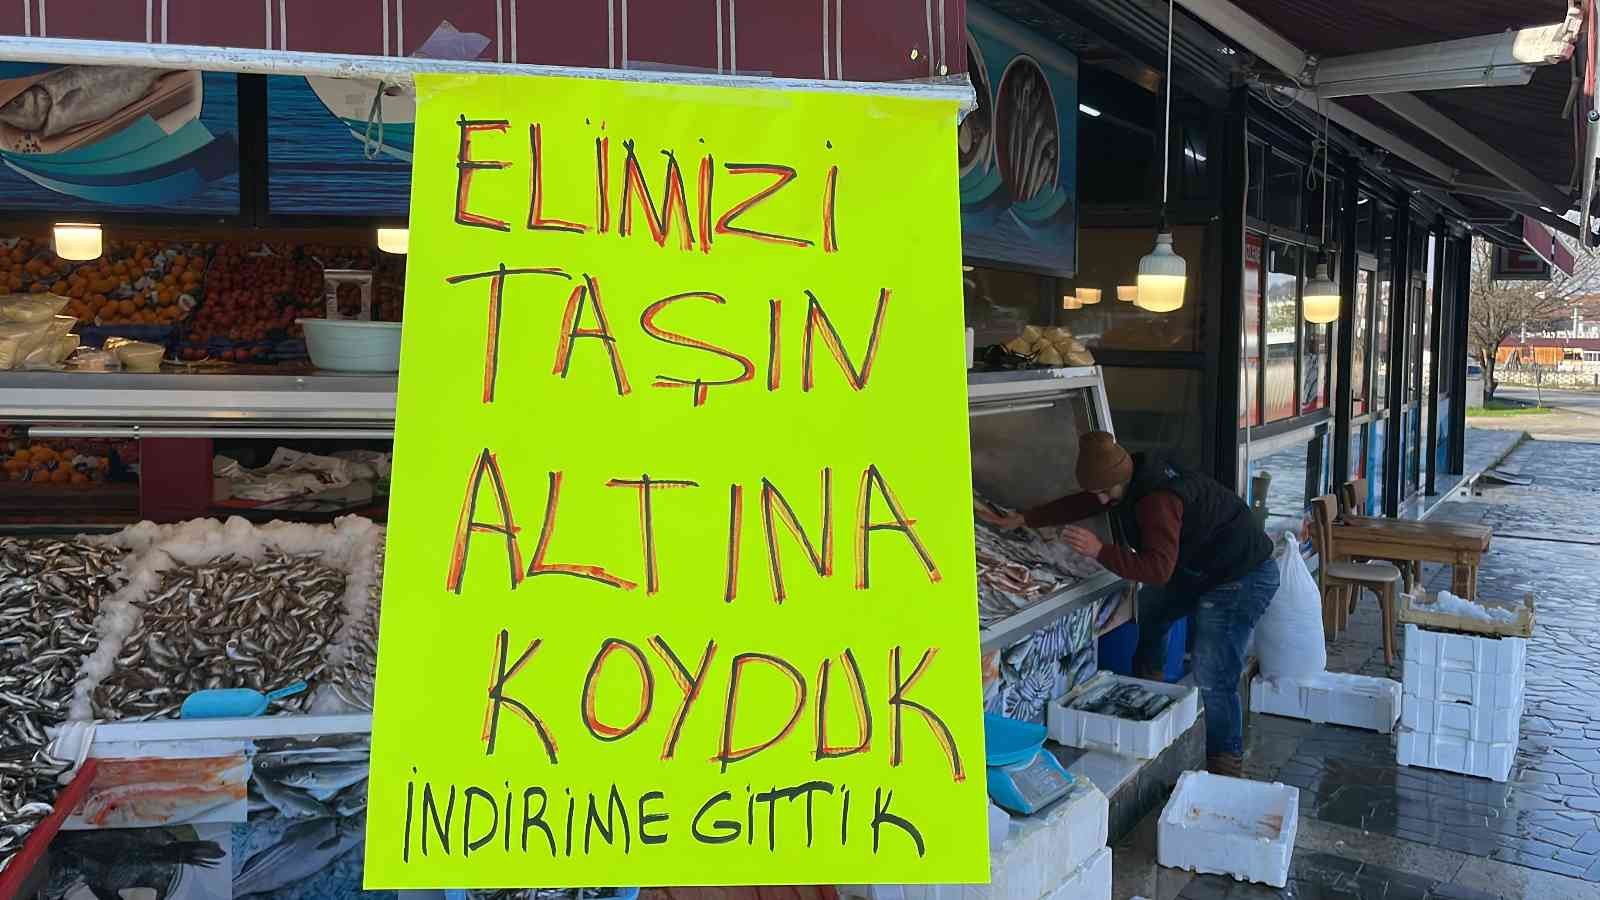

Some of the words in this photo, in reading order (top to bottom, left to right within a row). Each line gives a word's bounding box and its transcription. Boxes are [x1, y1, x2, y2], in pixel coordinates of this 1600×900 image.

[454, 113, 839, 254] ELİMİZİ
[445, 262, 891, 408] TAŞIN
[446, 447, 942, 605] ALTINA
[482, 628, 966, 783] KOYDUK
[403, 765, 670, 864] İNDİRİME
[691, 780, 926, 858] GİTTİK
